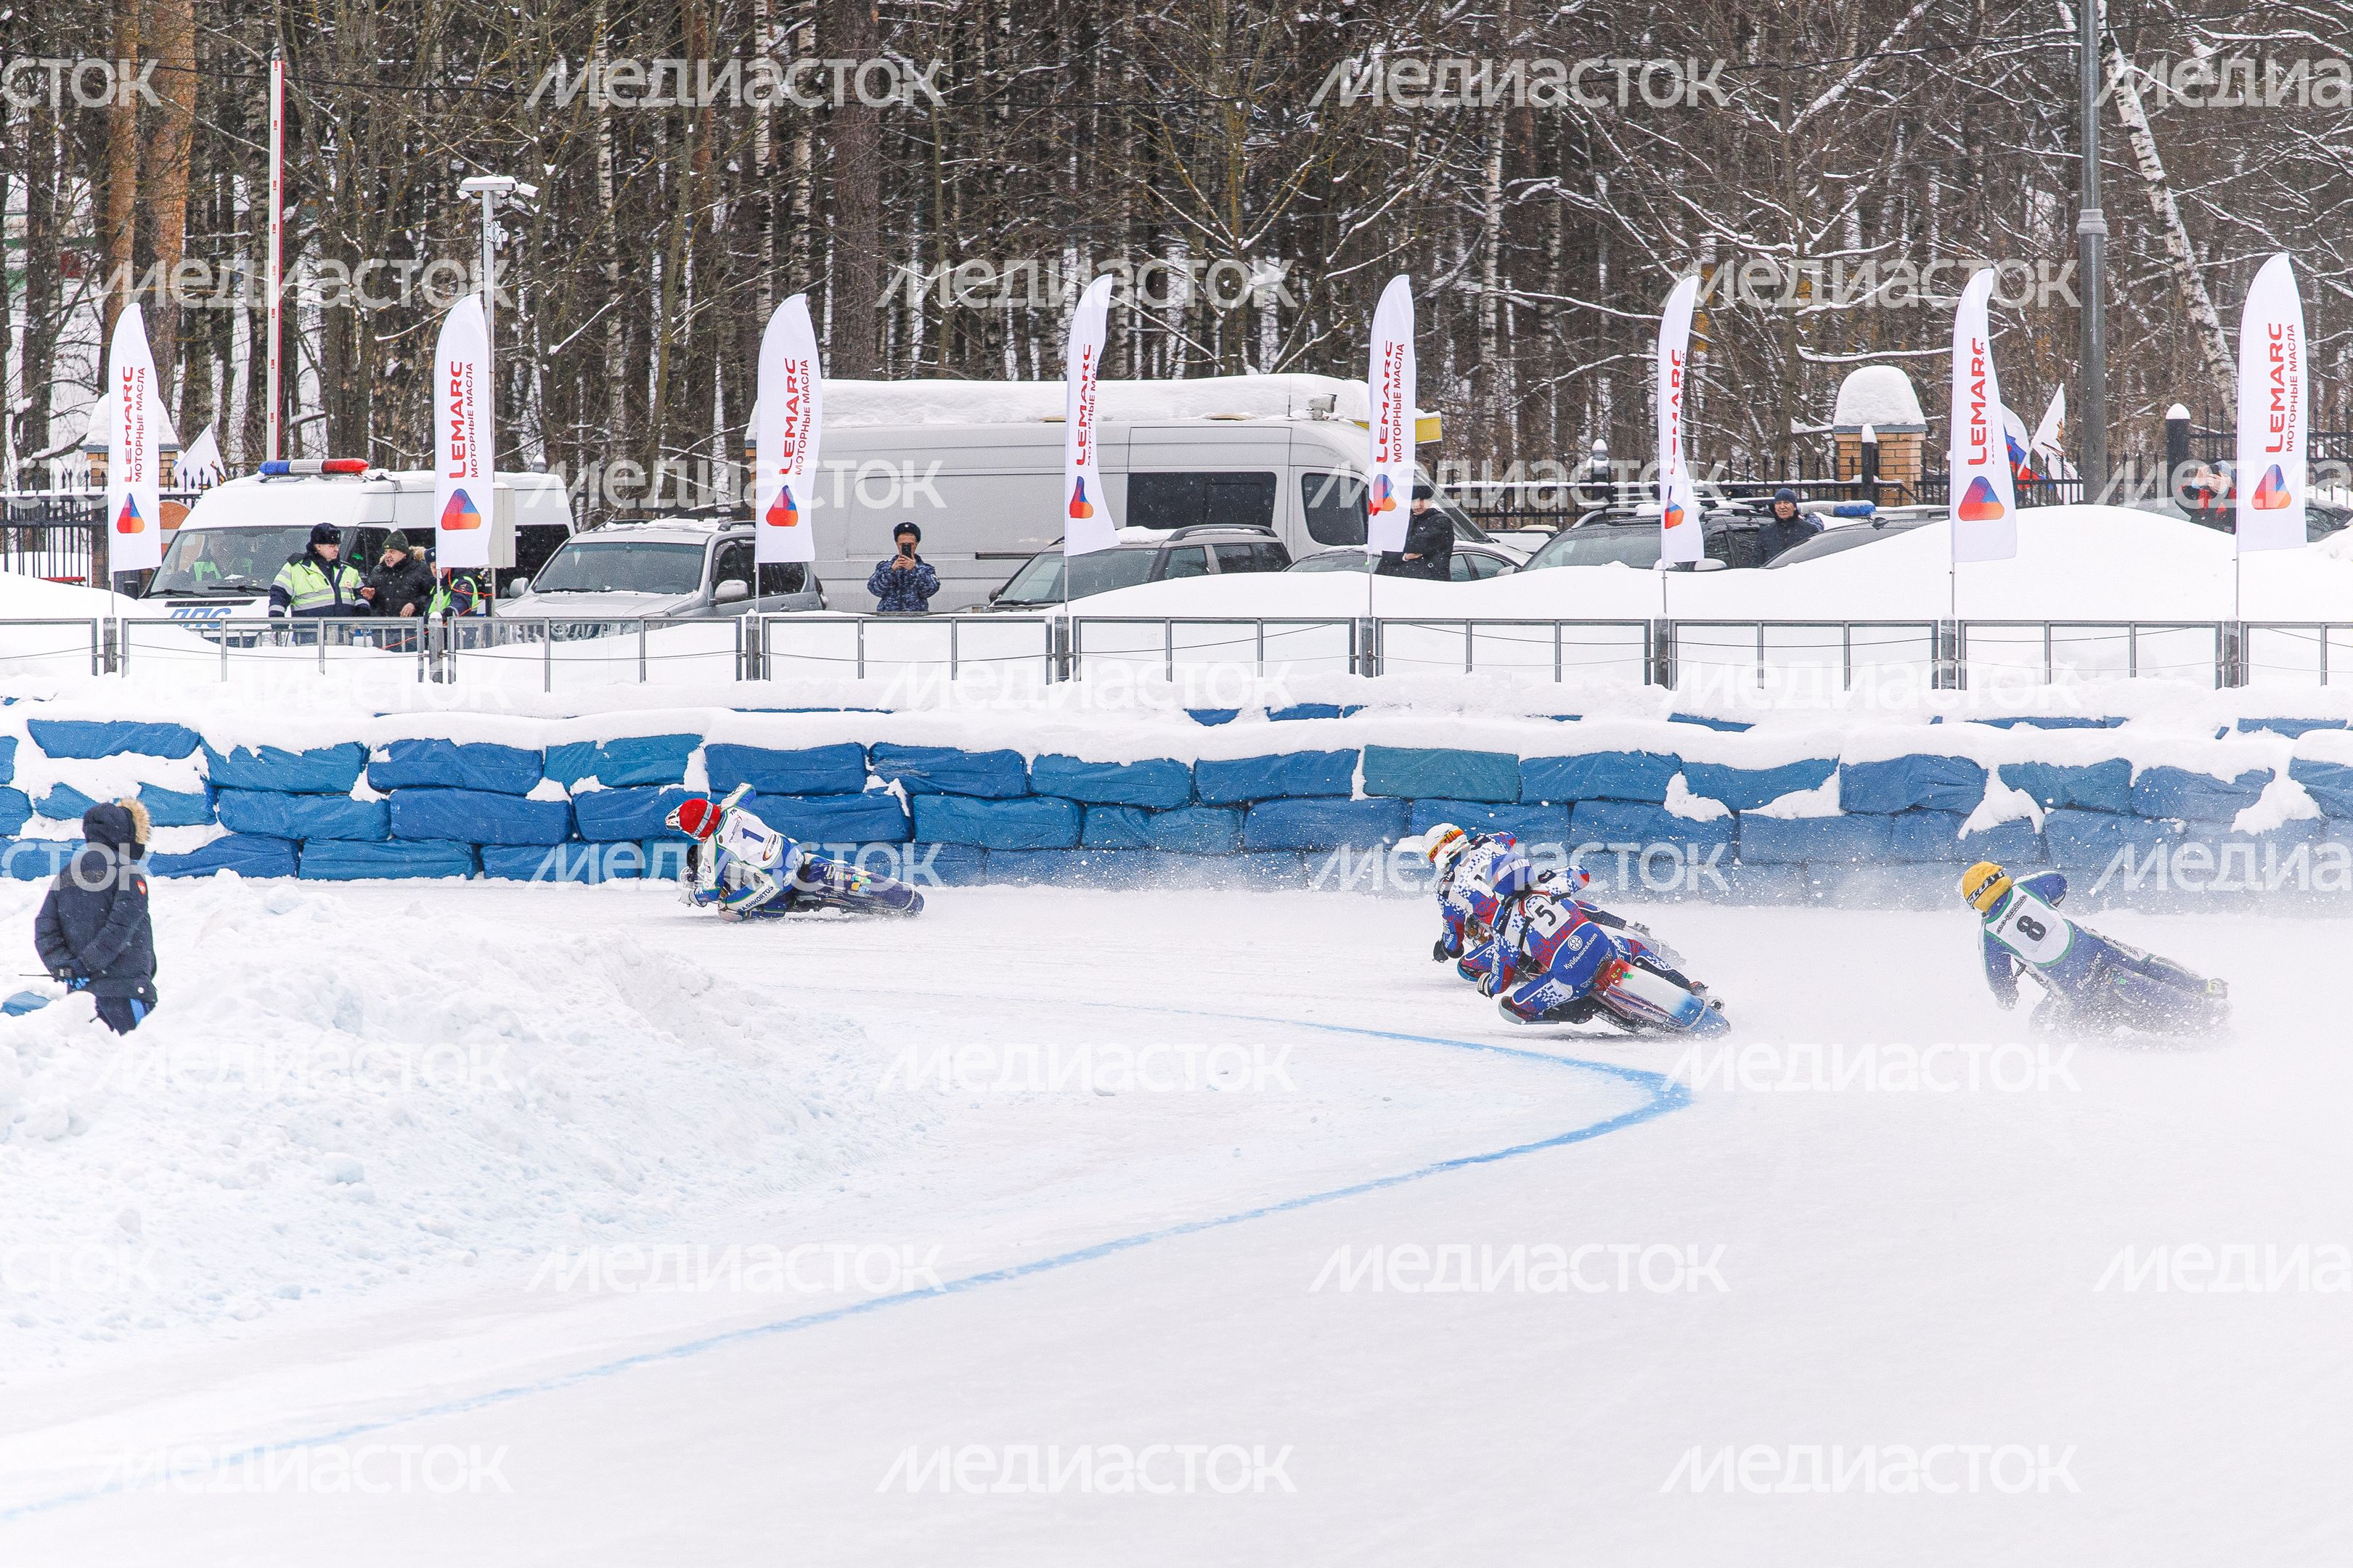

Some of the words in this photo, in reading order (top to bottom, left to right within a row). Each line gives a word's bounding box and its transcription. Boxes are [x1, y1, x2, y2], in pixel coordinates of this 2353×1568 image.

[800, 359, 810, 404] МАСЛА
[1393, 343, 1405, 389] МАСЛА
[2286, 324, 2298, 372] МАСЛА
[136, 367, 145, 410] МАСЛА
[449, 361, 466, 478] LEMARC
[778, 357, 800, 474] LEMARC
[1076, 343, 1091, 466] LEMARC
[1377, 340, 1392, 463] LEMARC
[2266, 323, 2285, 453] LEMARC
[2286, 375, 2298, 452] МОТОРНЫЕ
[123, 366, 134, 483] LEMARC
[135, 415, 144, 482] МОТОРНЫЕ
[466, 409, 479, 478] МОТОРНЫЕ
[794, 407, 810, 475] МОТОРНЫЕ
[1392, 392, 1403, 462] МОТОРНЫЕ
[168, 608, 232, 629] ДПС
[742, 828, 764, 843] 1
[1534, 905, 1557, 926] 5
[2016, 915, 2047, 942] 8
[1563, 933, 1598, 970] КуйбышевАзот
